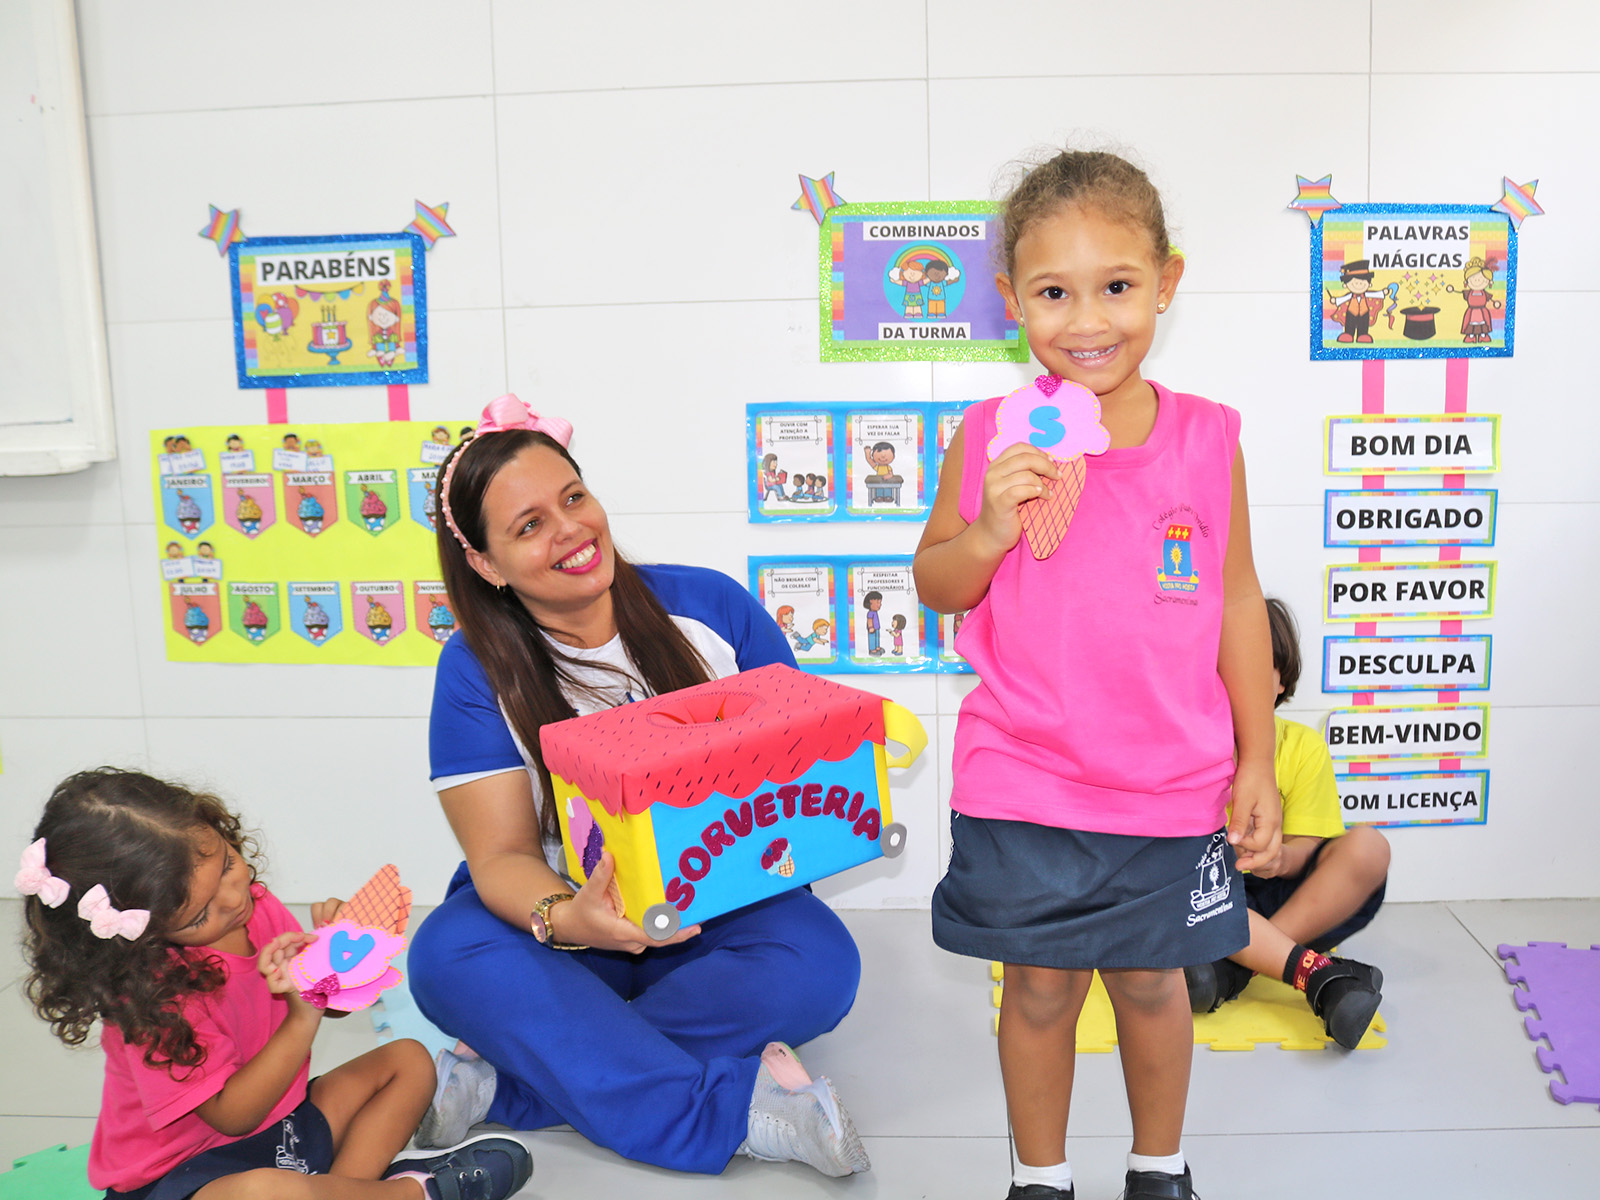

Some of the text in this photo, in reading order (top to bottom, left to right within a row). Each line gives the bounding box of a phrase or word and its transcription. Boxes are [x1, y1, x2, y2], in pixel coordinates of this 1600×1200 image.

[869, 225, 980, 238] COMBINADOS
[1367, 225, 1469, 241] PALAVRAS
[261, 252, 391, 282] PARABÉNS
[1372, 249, 1463, 268] MÁGICAS
[883, 326, 967, 339] DA TURMA
[1029, 405, 1066, 448] S
[1351, 434, 1473, 456] BOM DIA
[167, 478, 204, 489] JANEIRO
[292, 474, 326, 485] MARÇO
[357, 474, 384, 482] ABRIL
[421, 472, 437, 480] MA
[1336, 508, 1484, 530] OBRIGADO
[180, 585, 208, 595] JULHO
[234, 585, 272, 593] AGOSTO
[1333, 579, 1486, 603] POR FAVOR
[1339, 653, 1476, 675] DESCULPA
[1329, 721, 1482, 745] BEM-VINDO
[1338, 790, 1478, 811] OM LICENÇA
[665, 783, 882, 912] SORVETERIA
